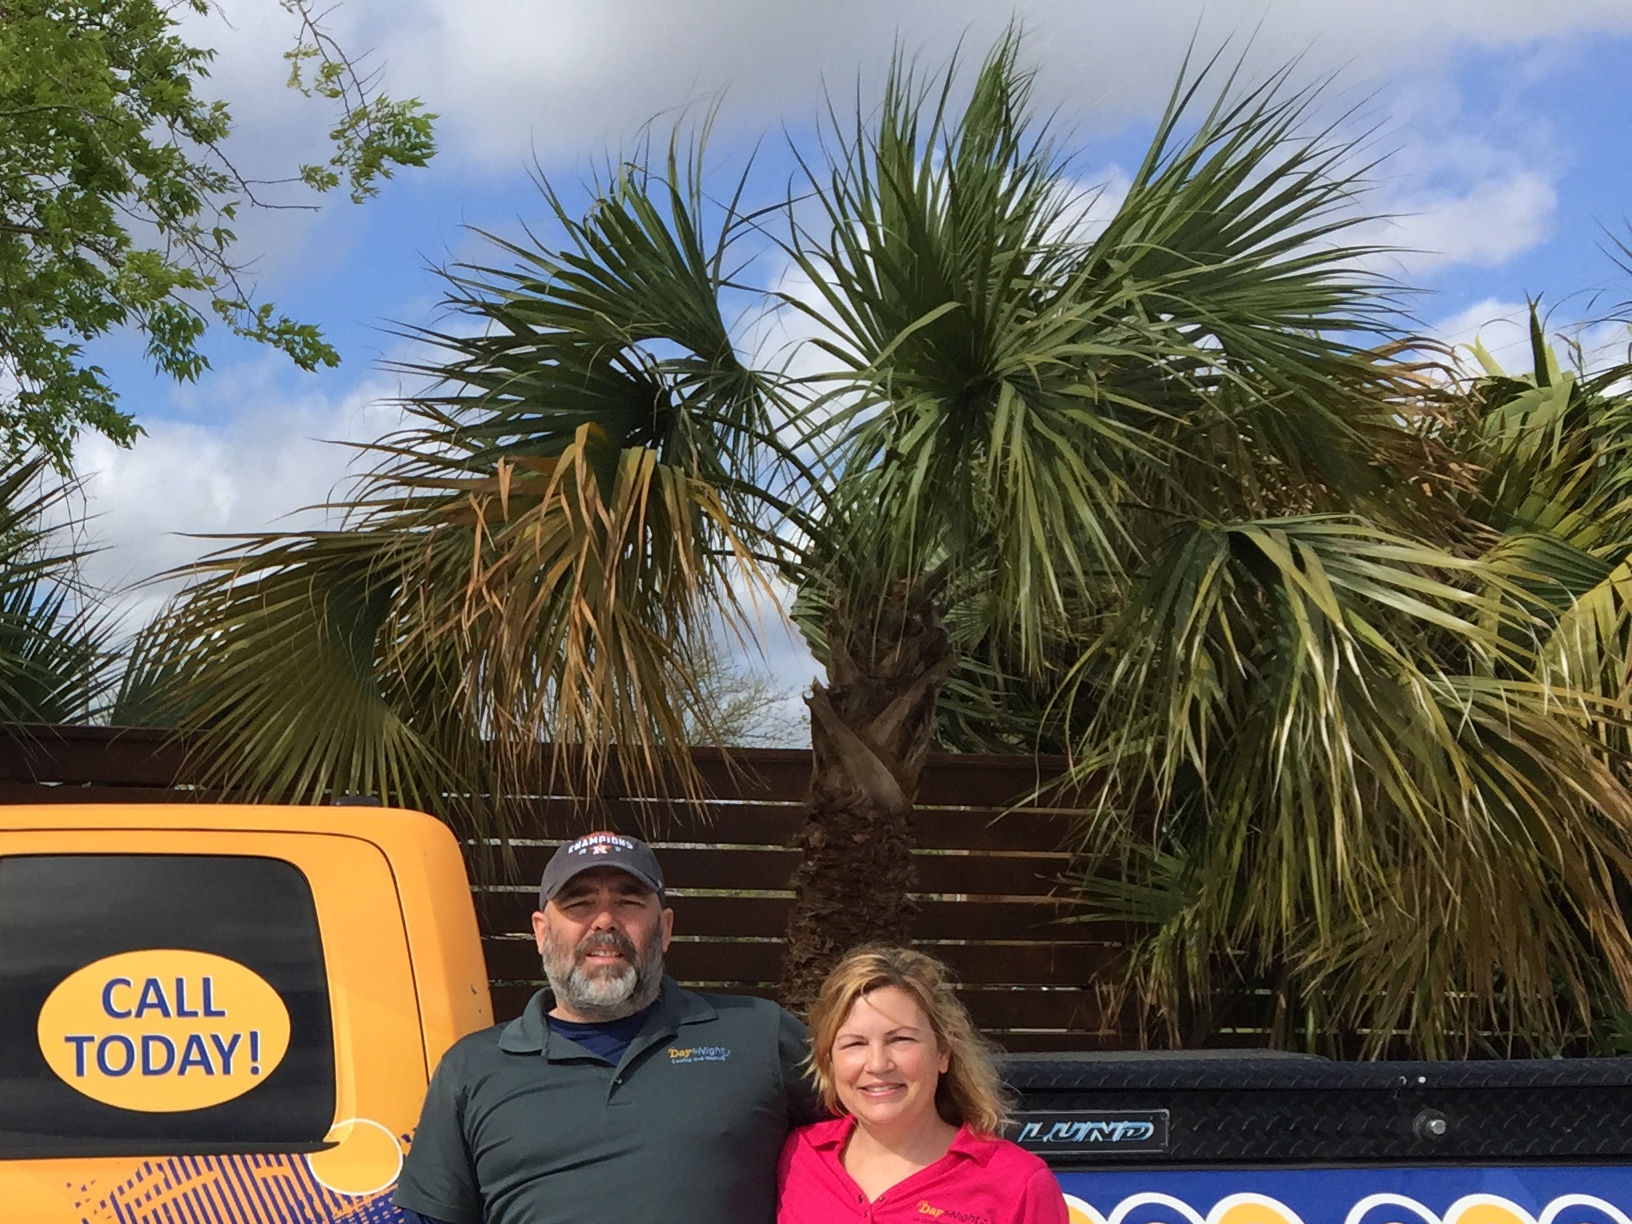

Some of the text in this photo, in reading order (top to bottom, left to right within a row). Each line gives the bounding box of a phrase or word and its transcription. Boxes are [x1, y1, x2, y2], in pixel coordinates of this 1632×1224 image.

[568, 835, 634, 854] CHAMPIONS
[101, 976, 227, 1019] CALL
[64, 1030, 261, 1078] TODAY!
[669, 1048, 692, 1058] Day
[698, 1046, 726, 1056] Night
[1018, 1121, 1155, 1142] LUND
[918, 1202, 945, 1217] Day
